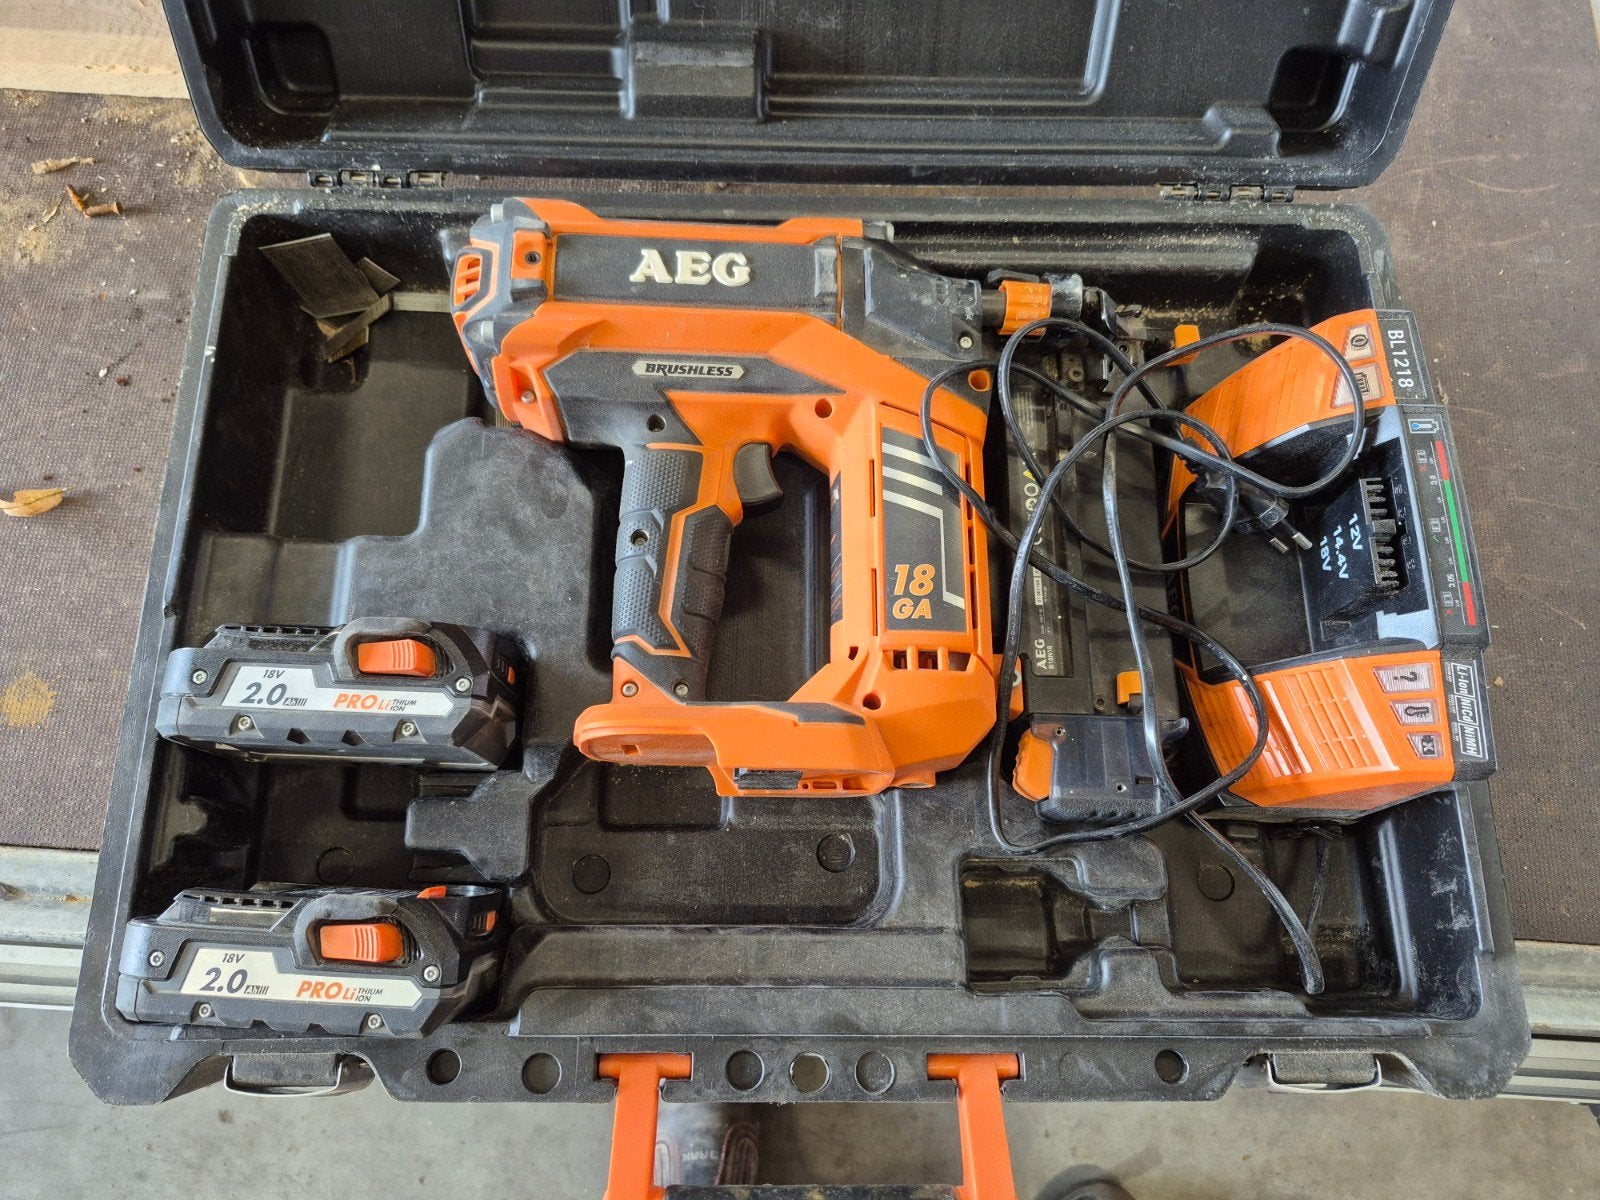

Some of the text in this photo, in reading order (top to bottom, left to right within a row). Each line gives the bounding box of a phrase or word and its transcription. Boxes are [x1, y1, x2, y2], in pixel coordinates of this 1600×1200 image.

[629, 248, 750, 287] AEG
[644, 363, 734, 377] BRUSHLESS
[1387, 329, 1414, 389] BL1218
[1349, 513, 1363, 550] 12V
[1320, 535, 1332, 571] 18V
[1333, 525, 1349, 579] 14.4V
[894, 563, 936, 596] 18
[892, 597, 932, 620] GA
[1035, 638, 1047, 670] AEG
[262, 669, 286, 679] 18V
[1457, 665, 1469, 695] Li-Ion
[240, 681, 288, 706] 2.0
[333, 693, 378, 710] PRO
[390, 704, 405, 712] ION
[1460, 698, 1473, 723] NiCd
[1464, 726, 1478, 755] NiMH
[221, 952, 246, 963] 18V
[199, 966, 248, 994] 2.0
[296, 980, 343, 1000] PRO
[355, 994, 371, 1002] ION
